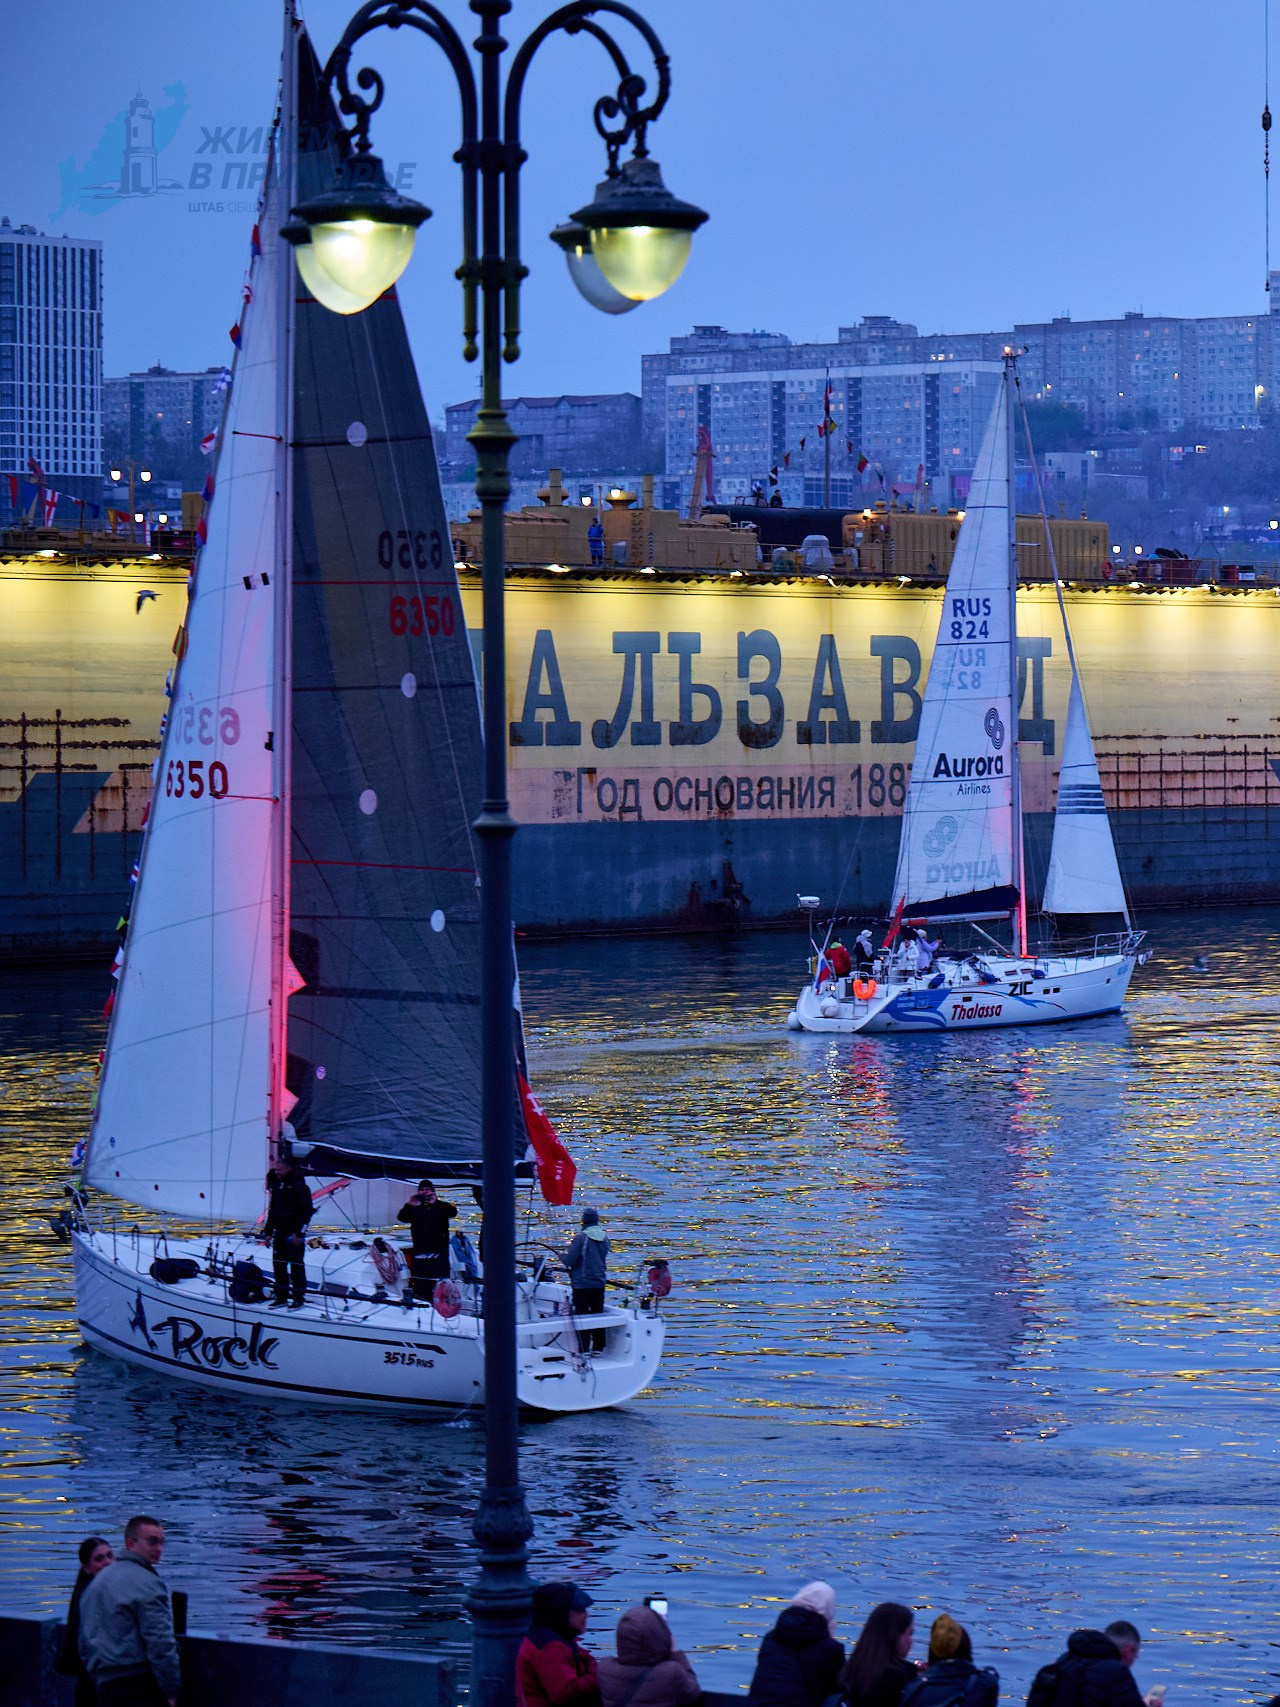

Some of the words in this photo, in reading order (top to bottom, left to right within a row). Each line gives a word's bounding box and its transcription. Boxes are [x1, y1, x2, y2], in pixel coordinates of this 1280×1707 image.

[390, 596, 454, 637] 6350
[952, 598, 992, 618] RUS
[950, 620, 989, 640] 824
[467, 628, 1055, 756] АЛЬЗАВД
[933, 753, 1004, 778] Aurora
[166, 760, 229, 799] 6350
[576, 768, 641, 820] Год
[653, 775, 835, 812] основания
[850, 763, 912, 809] 188
[957, 784, 991, 796] Airlines
[1008, 981, 1033, 997] ZIC
[951, 1004, 1002, 1021] Thalassa
[383, 1351, 417, 1366] 3515
